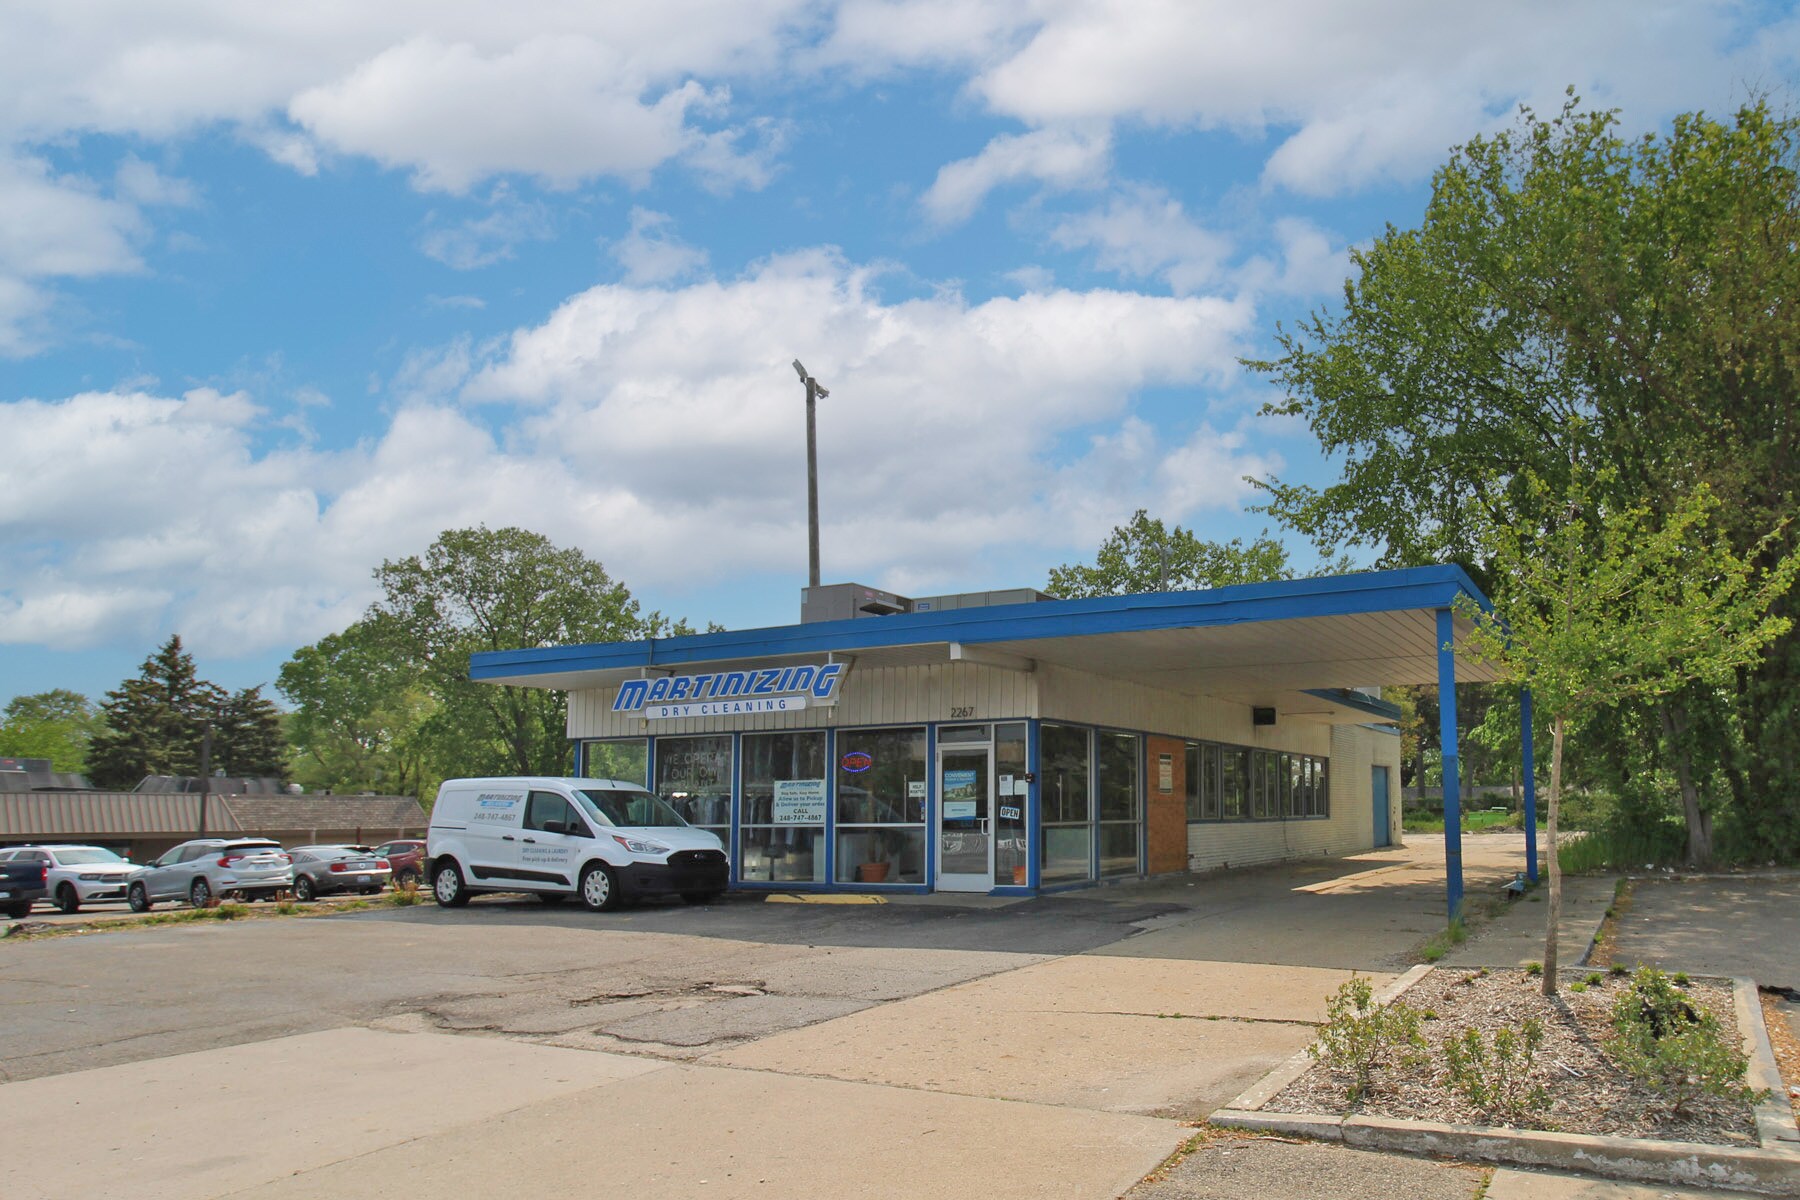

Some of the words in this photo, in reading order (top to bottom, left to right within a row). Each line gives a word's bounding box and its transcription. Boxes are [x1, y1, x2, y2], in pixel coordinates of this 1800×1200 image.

[612, 663, 844, 711] MARTINIZING
[661, 705, 690, 718] DRY
[701, 699, 787, 715] CLEANING
[950, 707, 974, 718] 2267
[841, 757, 872, 768] OPEN
[1001, 807, 1019, 818] OPEN
